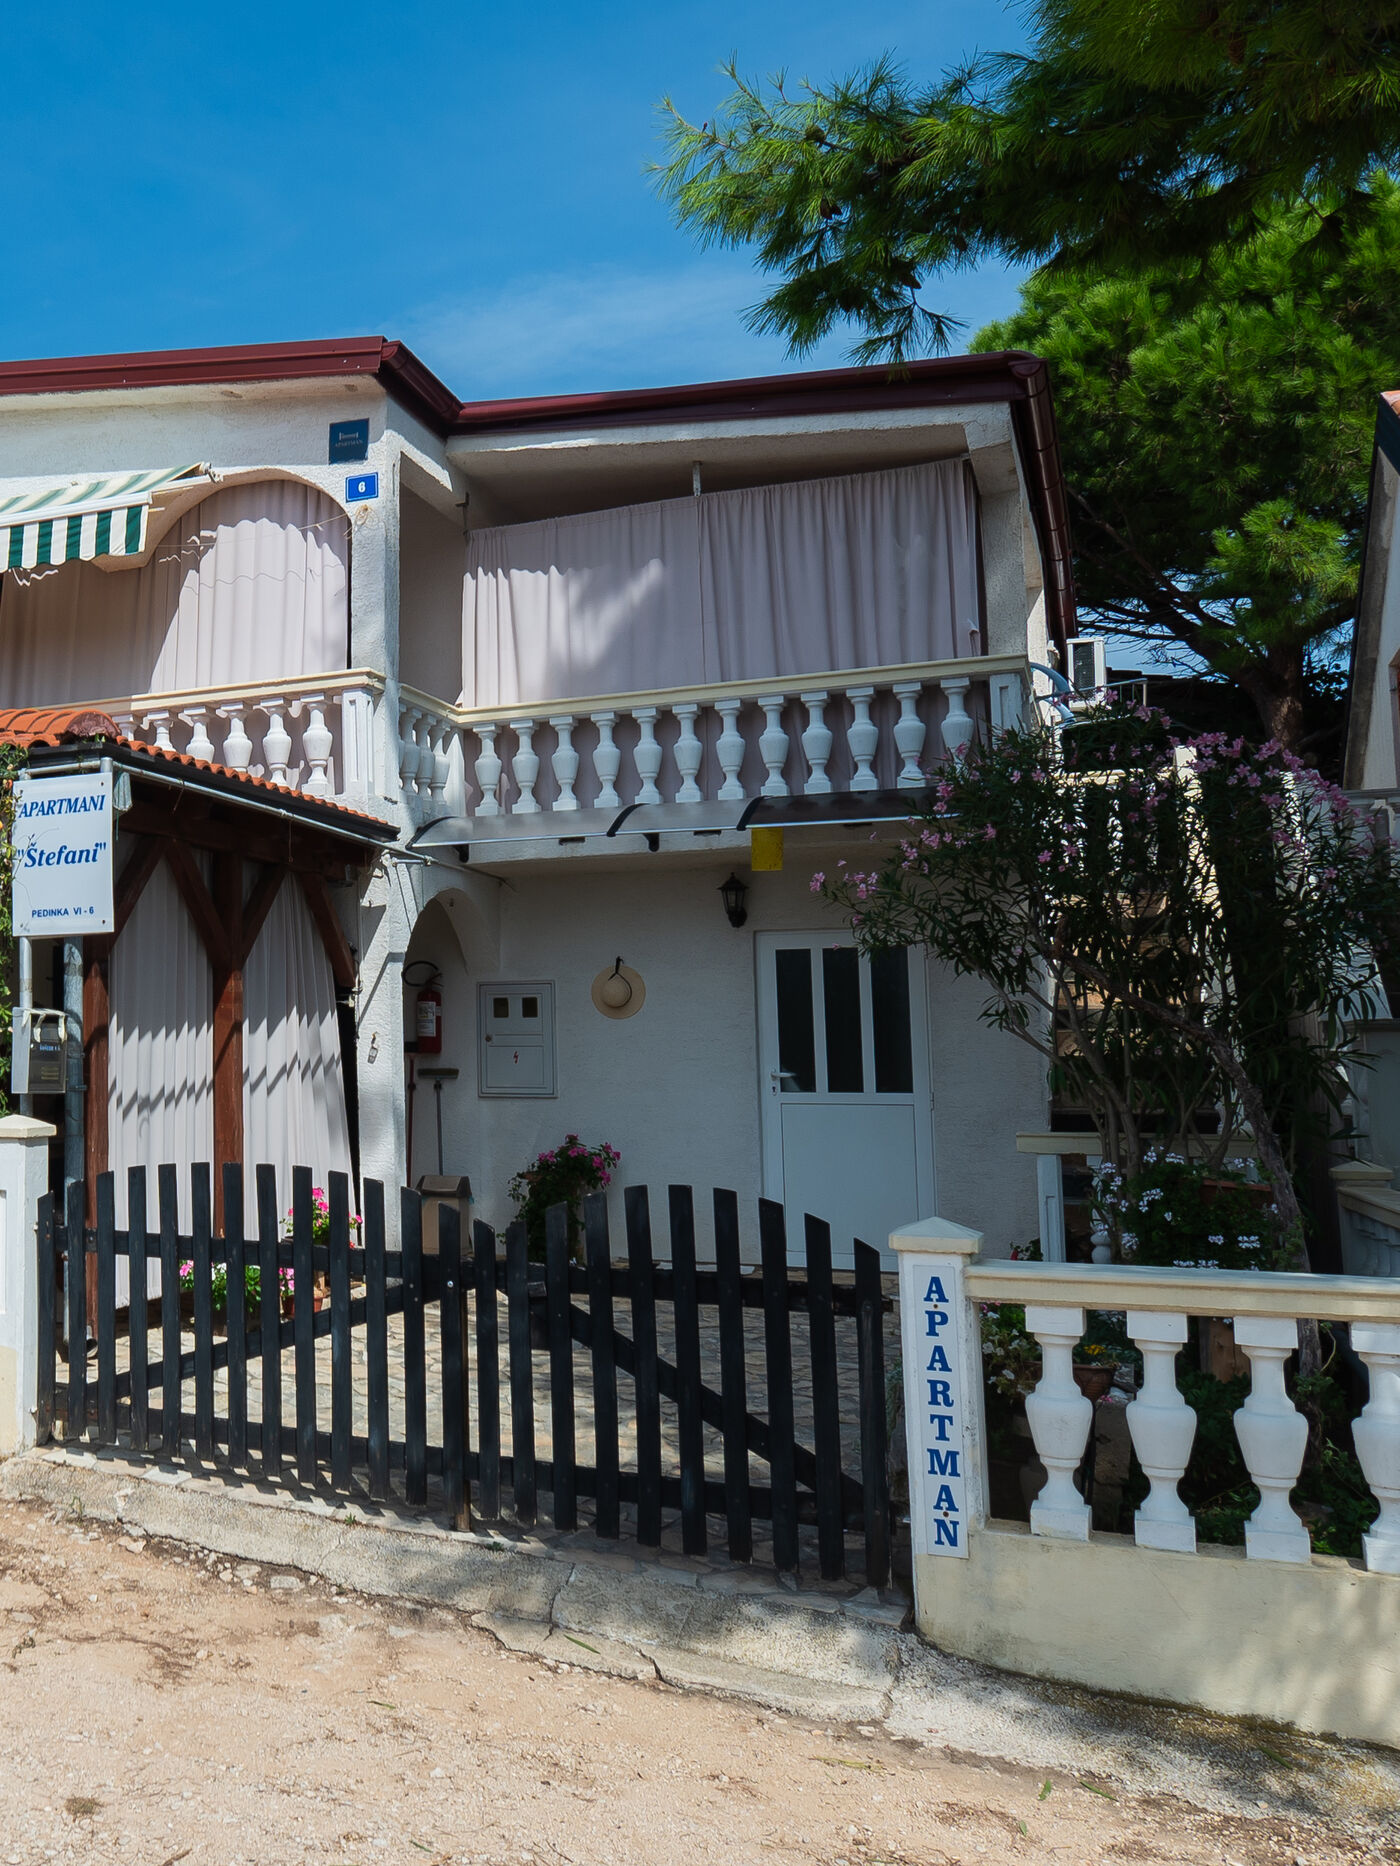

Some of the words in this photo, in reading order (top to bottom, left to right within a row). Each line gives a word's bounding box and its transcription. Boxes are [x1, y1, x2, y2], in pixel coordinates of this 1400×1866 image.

[358, 481, 366, 493] 6
[18, 794, 106, 819] APARTMANI
[17, 842, 107, 868] "Štefani"
[31, 907, 69, 918] PEDINKA
[73, 906, 82, 916] VI
[89, 906, 95, 915] 6
[923, 1276, 961, 1547] APARTMAN
